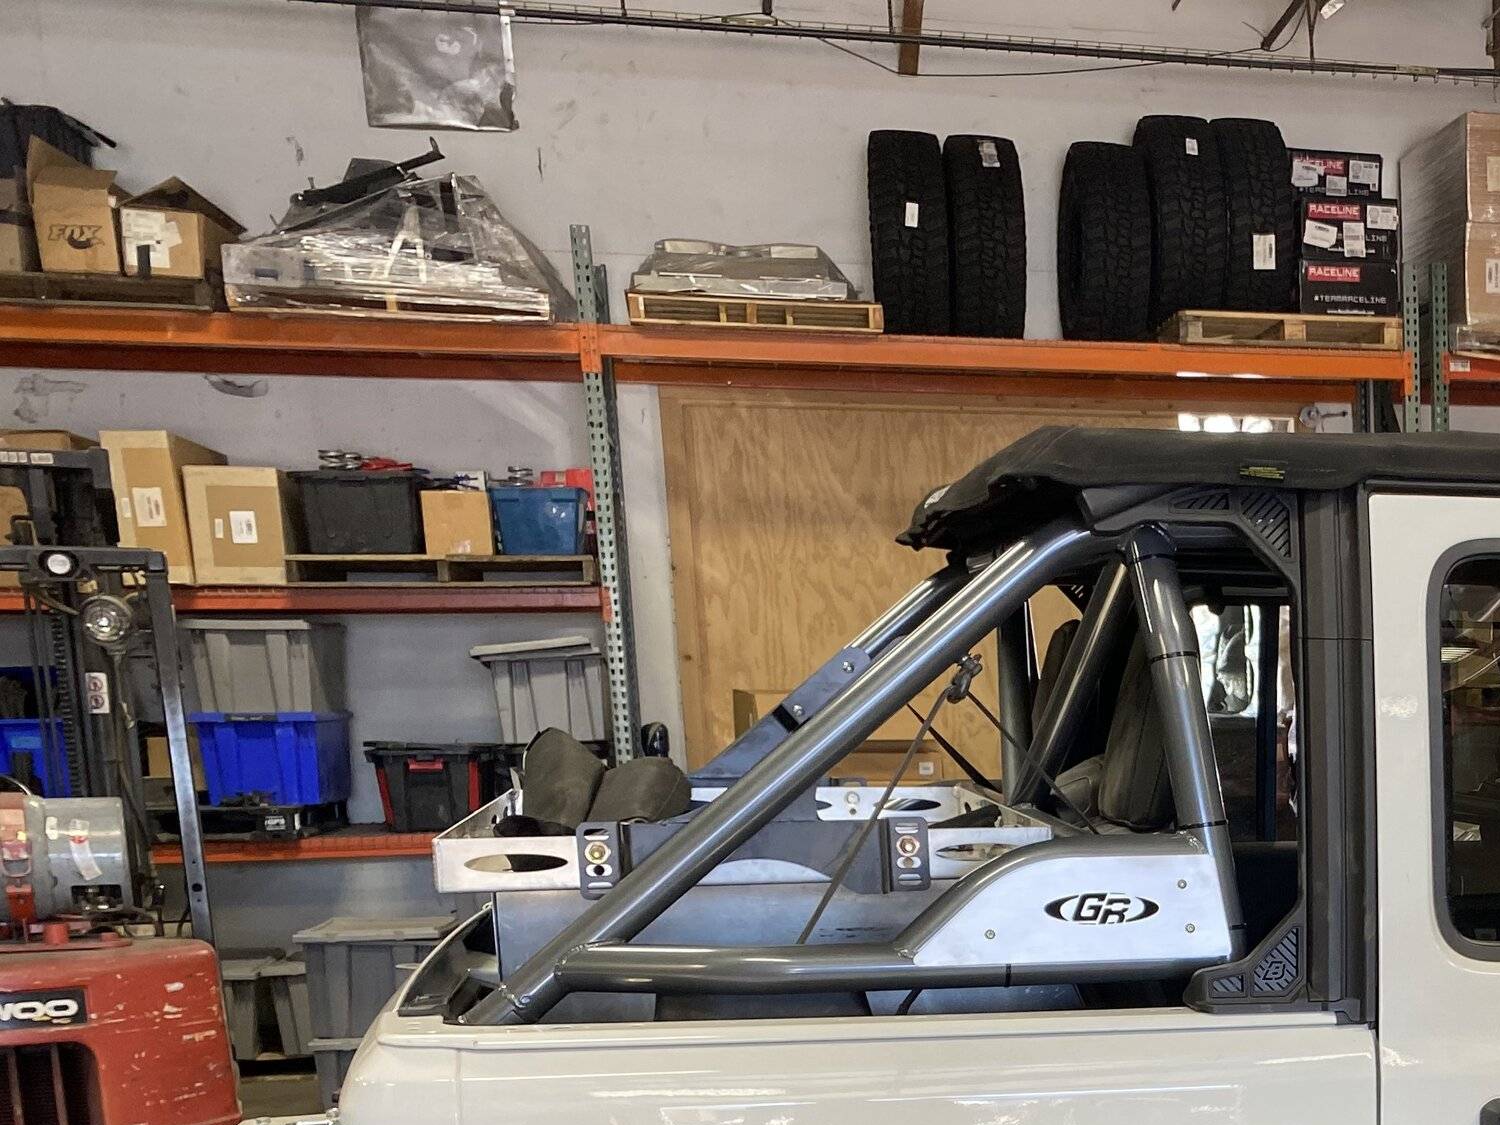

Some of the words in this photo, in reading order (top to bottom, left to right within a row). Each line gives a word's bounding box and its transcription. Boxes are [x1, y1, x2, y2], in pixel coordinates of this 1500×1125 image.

[1309, 203, 1360, 215] RACELINE
[48, 223, 104, 247] FOX
[1308, 266, 1360, 278] RACELINE
[1072, 893, 1131, 925] GR
